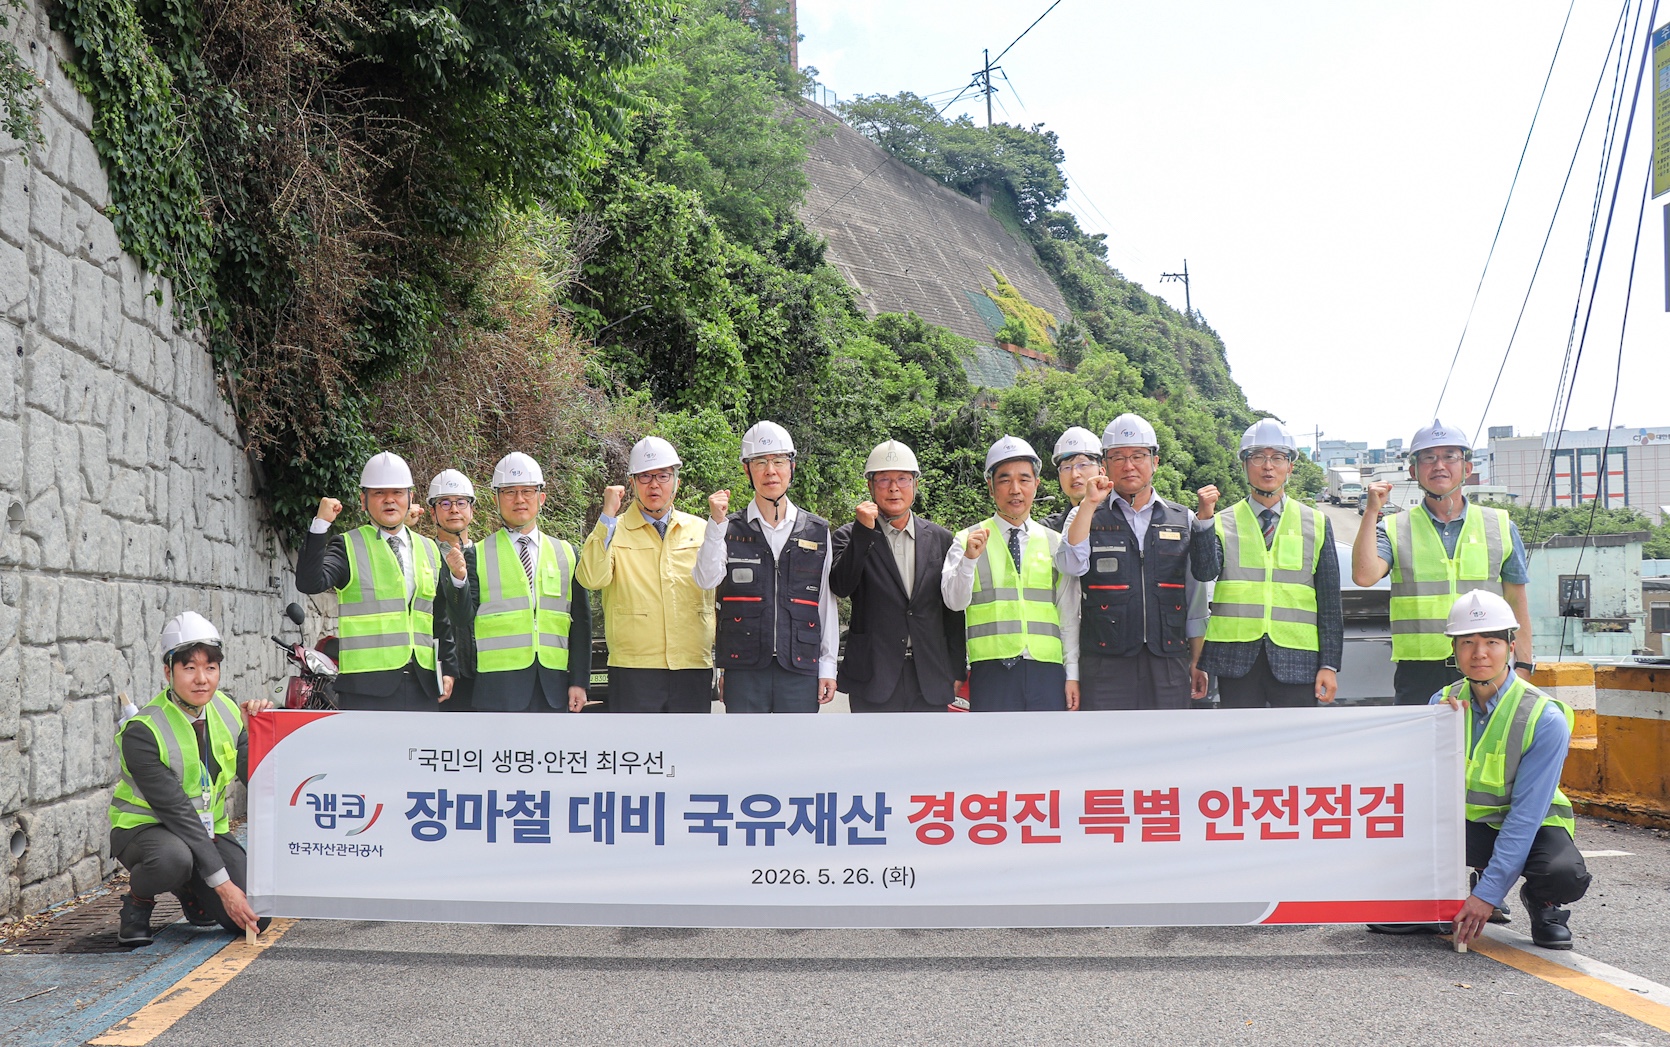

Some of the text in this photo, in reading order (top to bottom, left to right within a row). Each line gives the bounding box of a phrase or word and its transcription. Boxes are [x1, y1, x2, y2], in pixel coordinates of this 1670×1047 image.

[306, 793, 366, 830] 캠코
[404, 783, 1405, 847] 장마철 대비 국유재산 경영진 특별 안전점검
[288, 841, 384, 858] 한국자산관리공사
[751, 866, 916, 889] 2026. 5. 26. (화)
